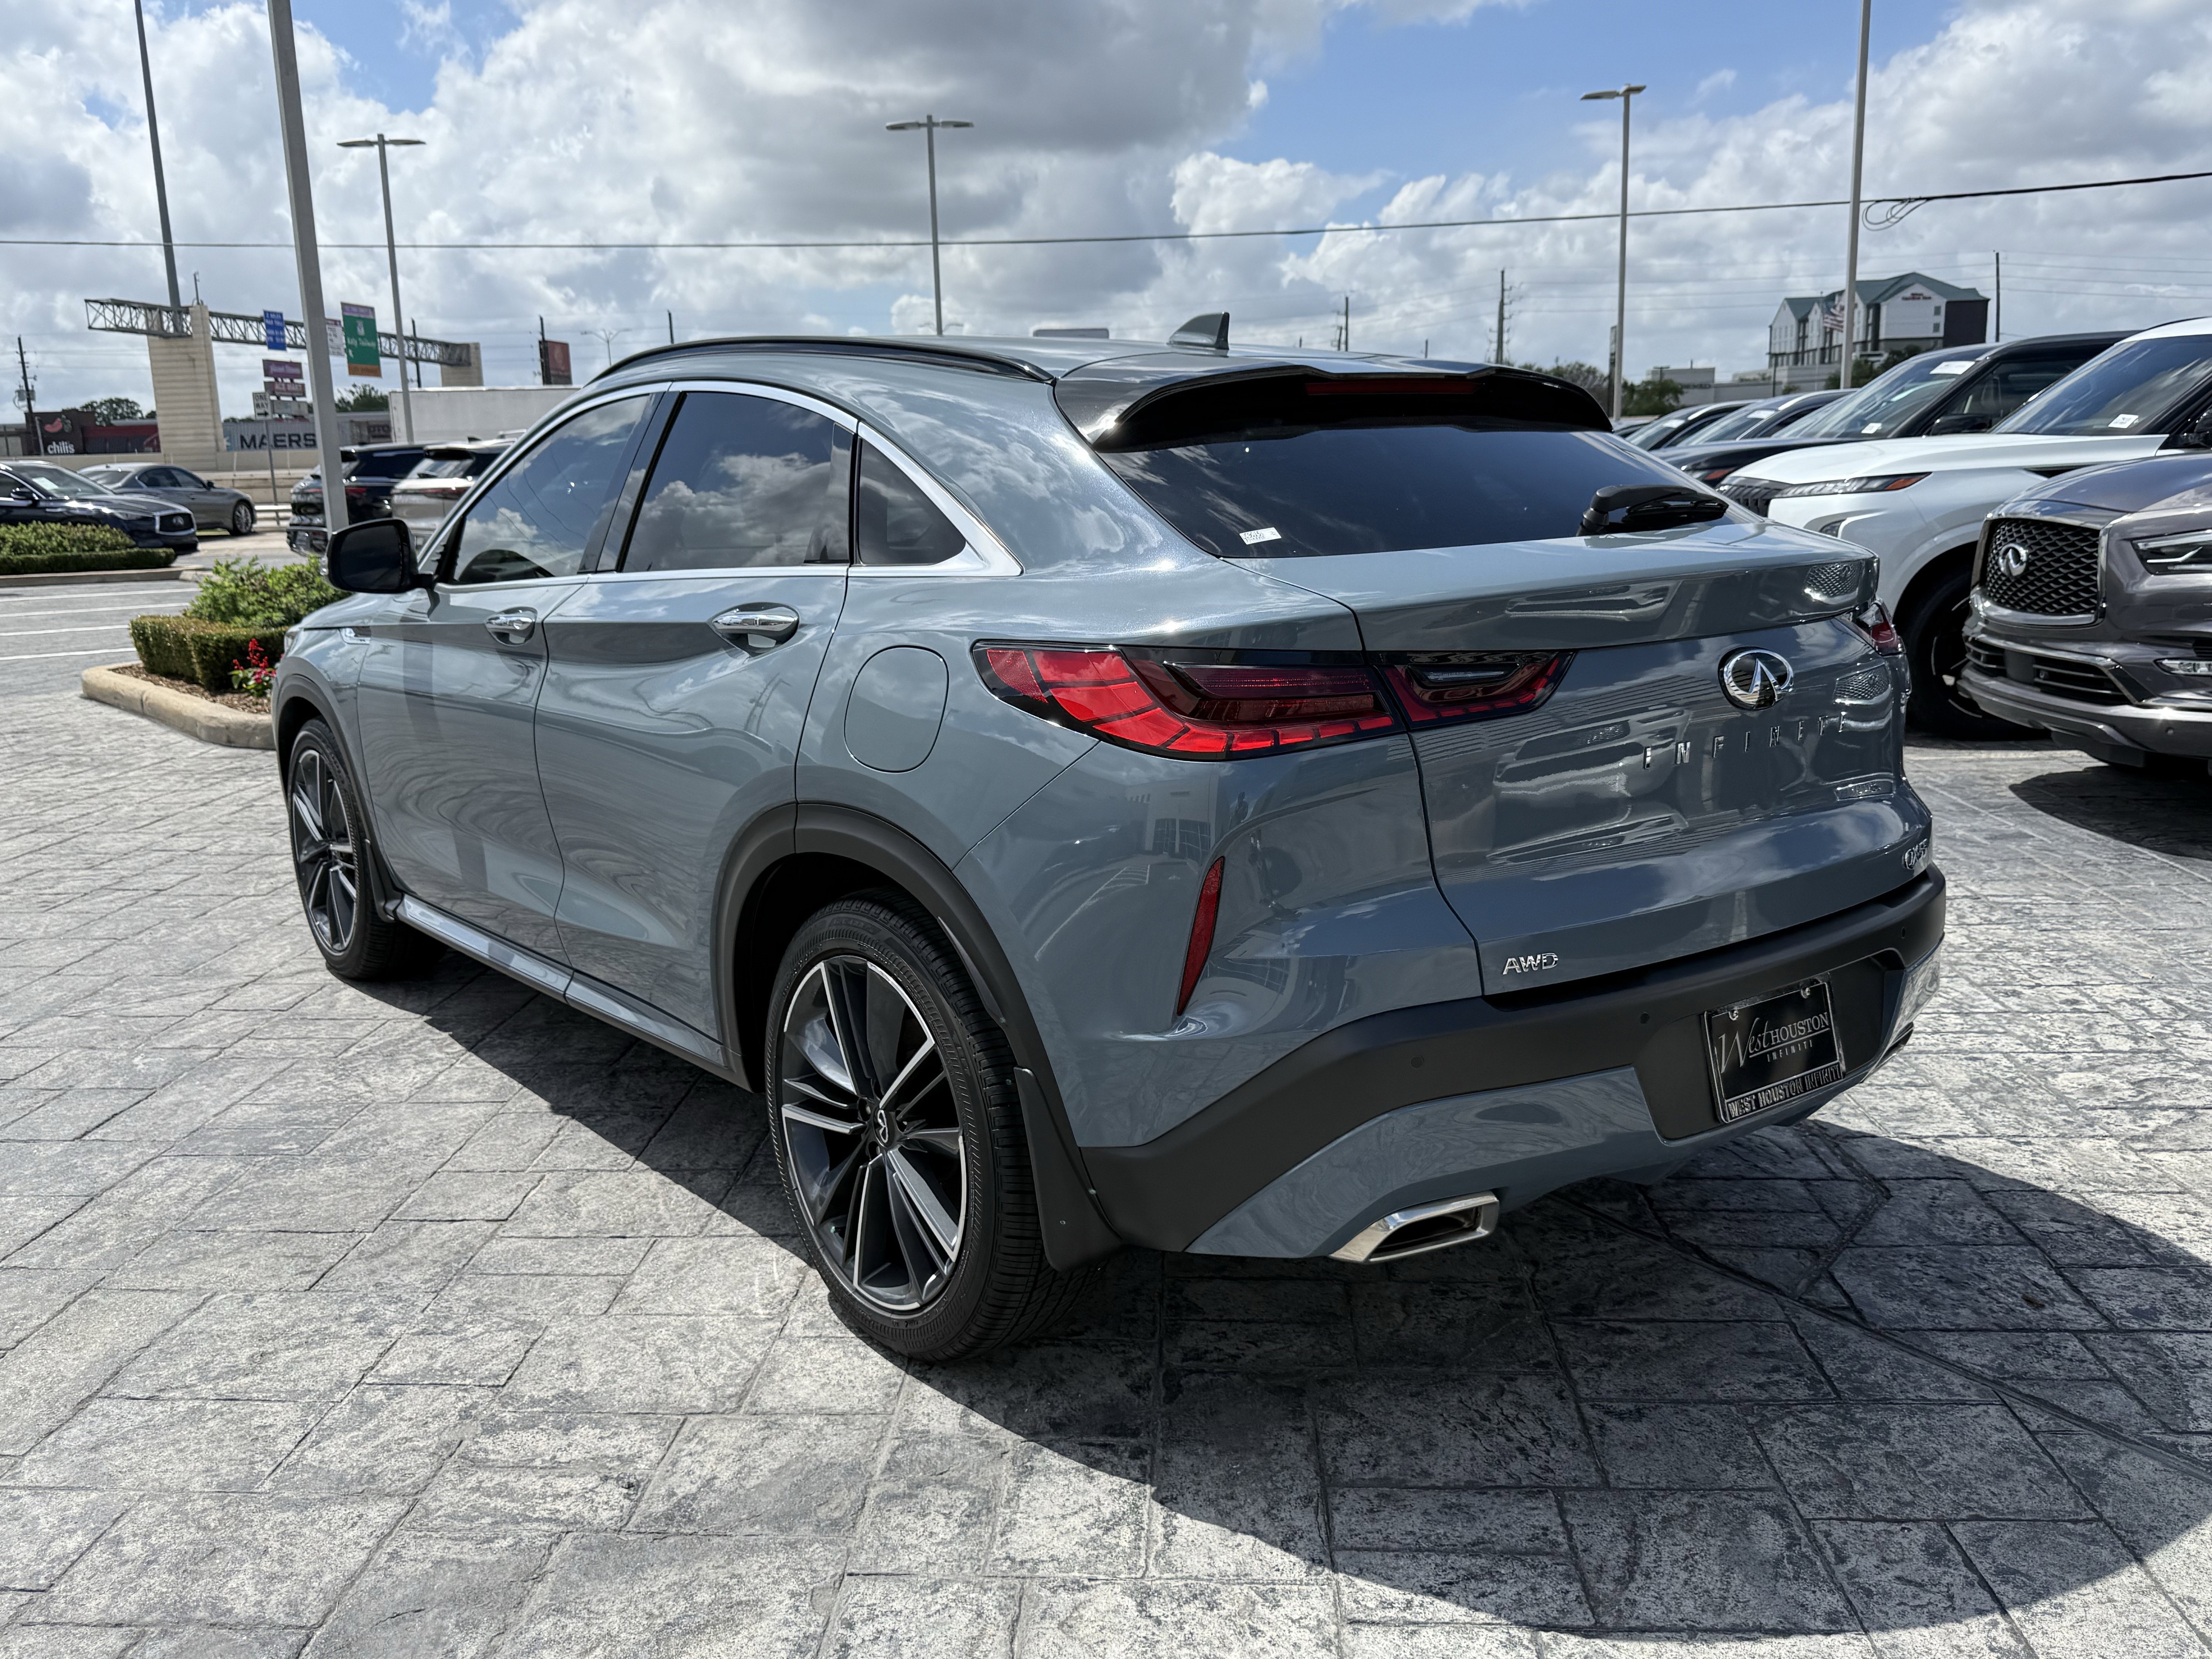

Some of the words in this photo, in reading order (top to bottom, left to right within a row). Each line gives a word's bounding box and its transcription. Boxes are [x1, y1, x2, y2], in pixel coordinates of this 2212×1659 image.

[240, 433, 317, 449] MAERS
[1643, 711, 1847, 769] INFINITI
[1502, 952, 1559, 975] AWD
[1767, 1039, 1812, 1062] INFINITI
[1728, 1094, 1756, 1118] WEST
[1758, 1079, 1804, 1108] HOUSTON
